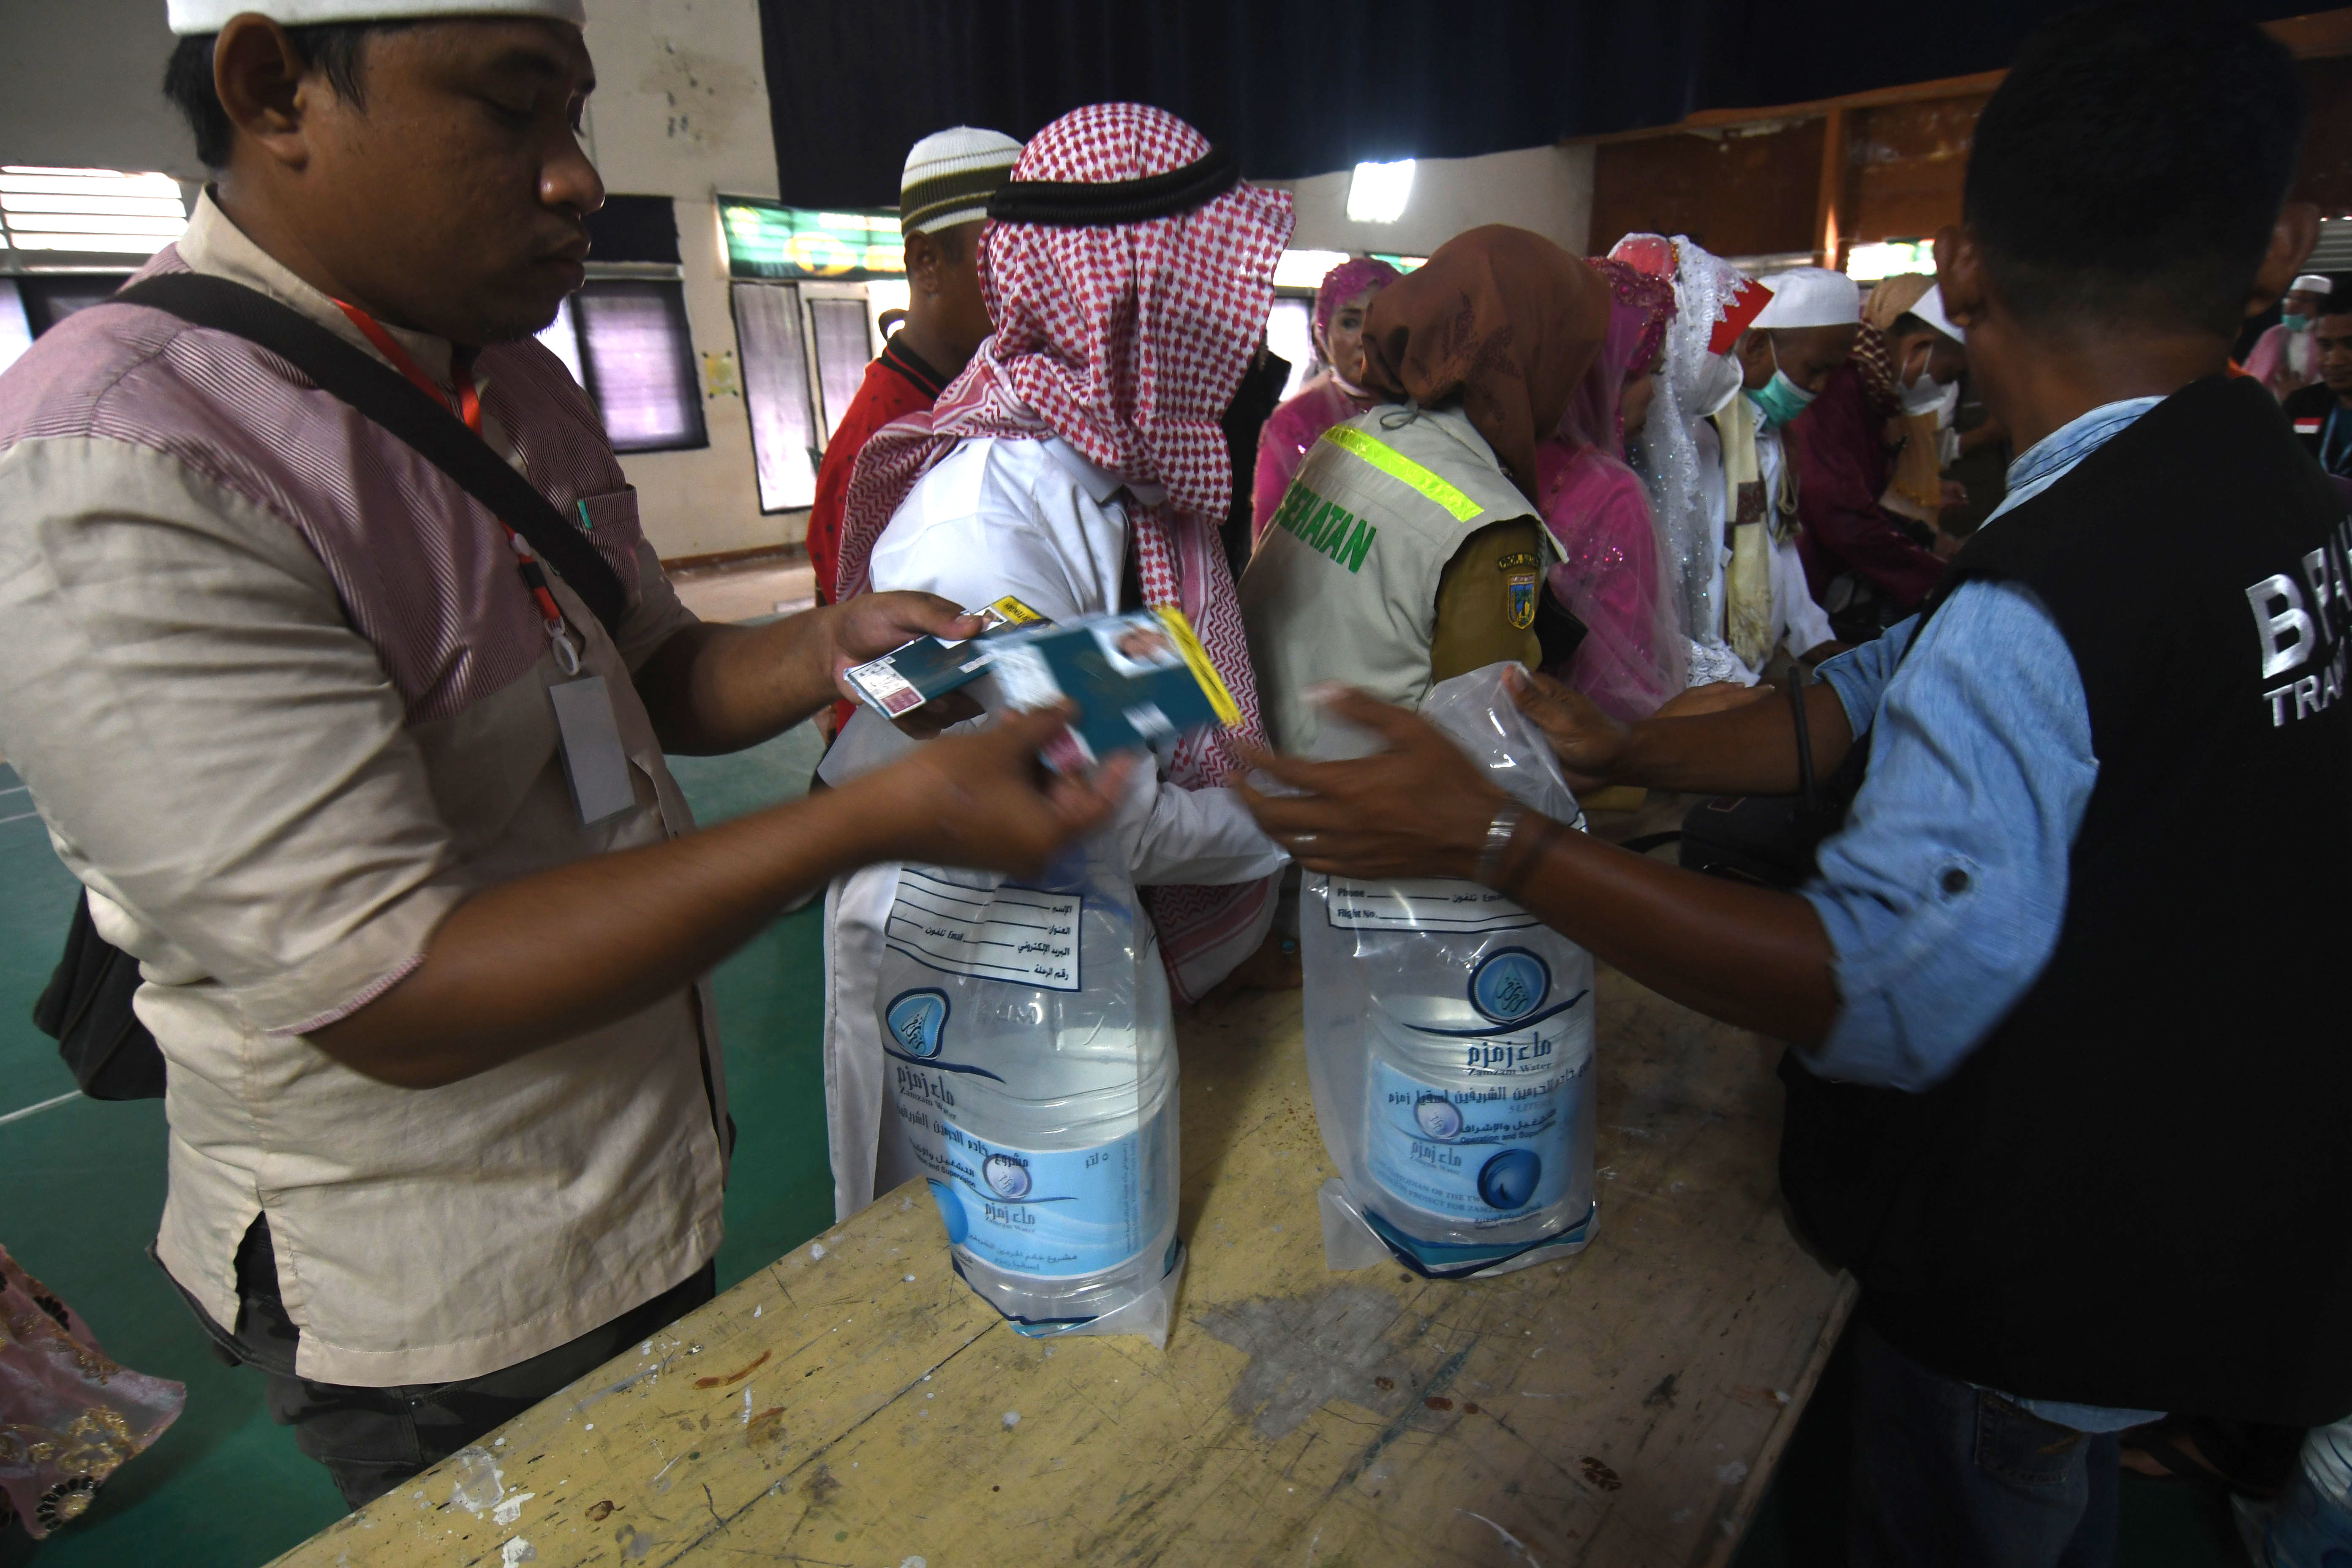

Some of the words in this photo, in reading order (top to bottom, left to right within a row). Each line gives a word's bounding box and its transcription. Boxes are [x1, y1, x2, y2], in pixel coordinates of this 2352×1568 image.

[1337, 888, 1365, 897] Phone
[1337, 908, 1361, 919] Flight
[947, 931, 964, 941] Email
[1467, 1040, 1513, 1069] زمزم
[1516, 1031, 1551, 1061] ماء
[1519, 1062, 1552, 1072] Water
[896, 1065, 929, 1098] زمزم
[930, 1075, 955, 1106] ماء
